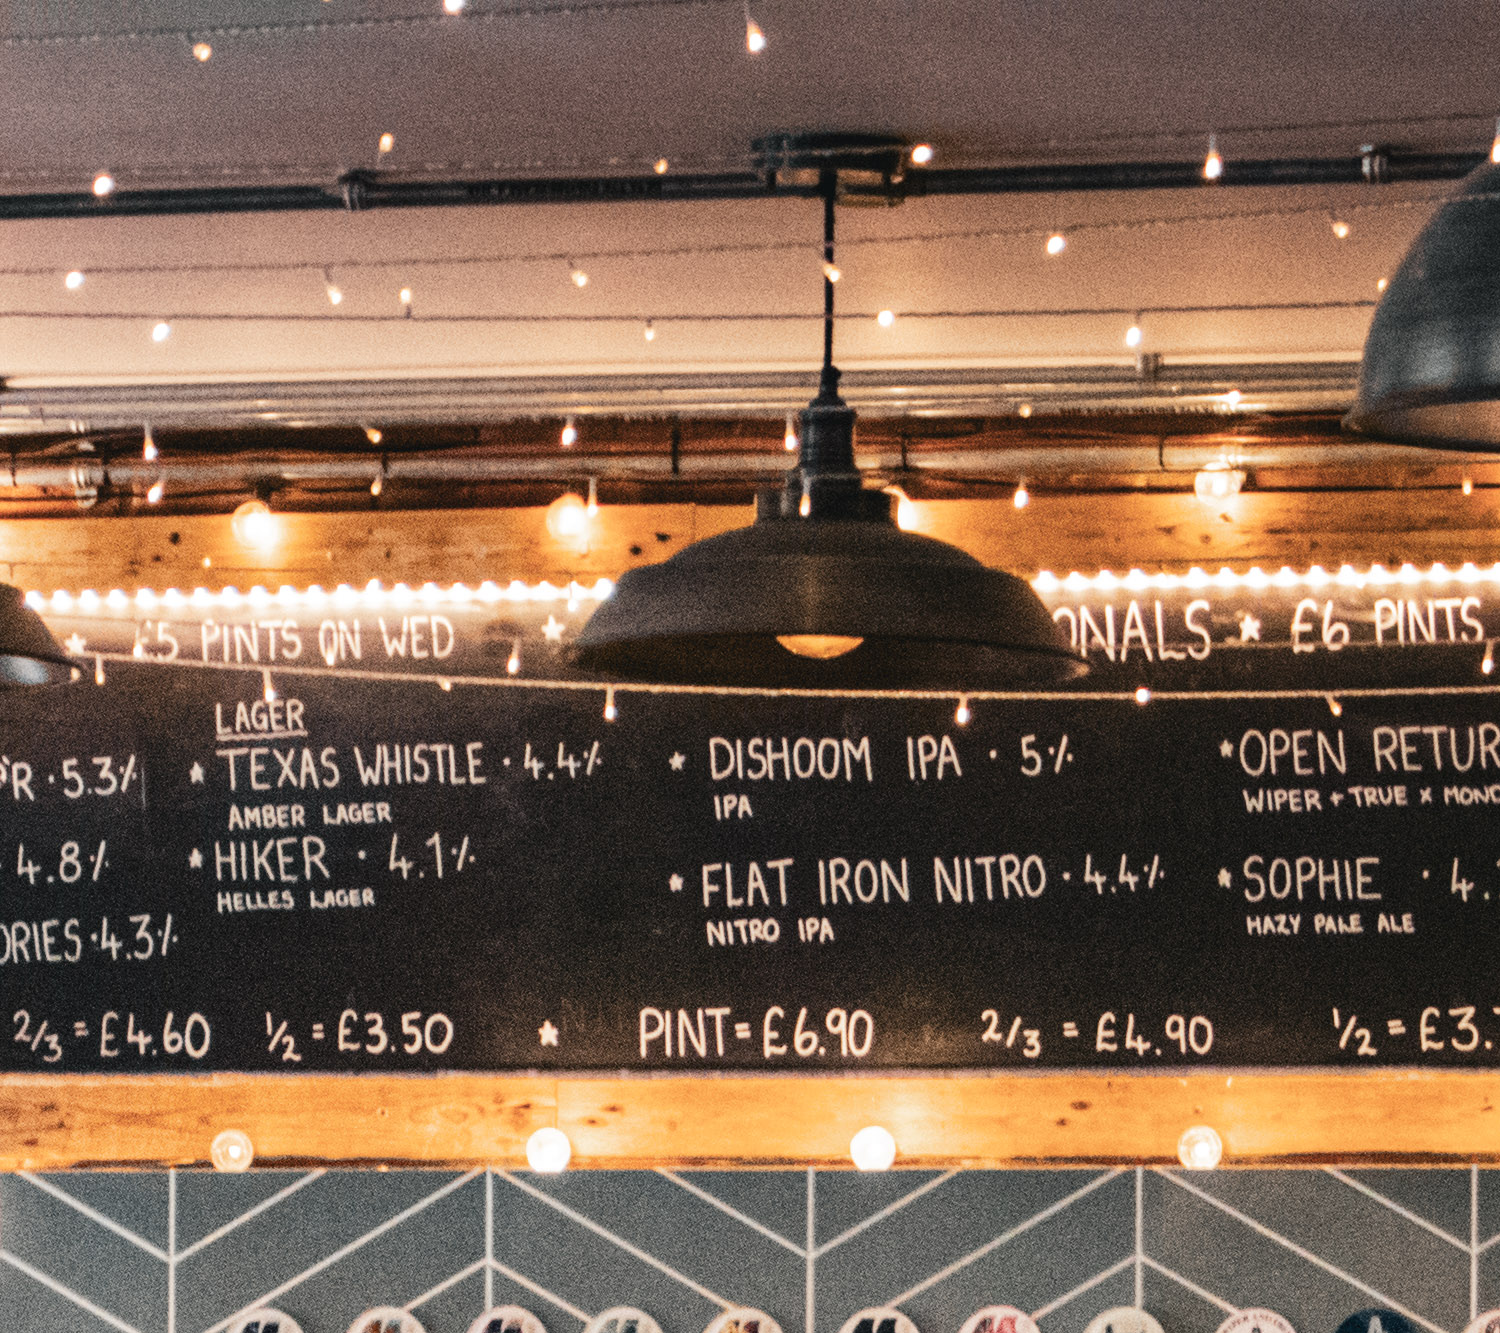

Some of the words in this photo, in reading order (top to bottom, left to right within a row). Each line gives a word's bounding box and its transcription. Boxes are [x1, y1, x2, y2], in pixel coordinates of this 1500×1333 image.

[200, 618, 302, 662] PINTS
[318, 617, 361, 662] ON
[378, 615, 455, 659] WED
[1292, 598, 1350, 654] £6
[1375, 596, 1483, 645] PINTS
[216, 698, 305, 736] LAGER
[216, 746, 340, 791] TEXAS
[354, 742, 487, 787] WHISTLE
[709, 735, 873, 782] DISHOOM
[907, 734, 963, 780] IPA
[1021, 734, 1073, 777] 5%
[1239, 728, 1347, 777] OPEN
[228, 805, 306, 831] AMBER
[323, 802, 392, 826] LAGER
[713, 794, 754, 820] IPA
[1242, 788, 1323, 813] WIPER
[1348, 785, 1408, 808] TRUE
[216, 835, 330, 883] HIKER
[702, 858, 794, 908] FLAT
[818, 857, 910, 904] IRON
[934, 854, 1047, 903] NITRO
[1243, 856, 1382, 902] SOPHIE
[217, 890, 295, 914] HELLES
[310, 888, 375, 909] LAGER
[1246, 914, 1302, 936] HAZY
[1314, 912, 1365, 935] PALE
[1377, 912, 1416, 934] ALE
[706, 919, 781, 946] NITRO
[799, 917, 835, 942] IPA
[99, 1011, 211, 1058] £4.60
[337, 1008, 454, 1054] £3.50
[763, 1006, 875, 1059] £6.90
[1095, 1010, 1215, 1056] £4.90
